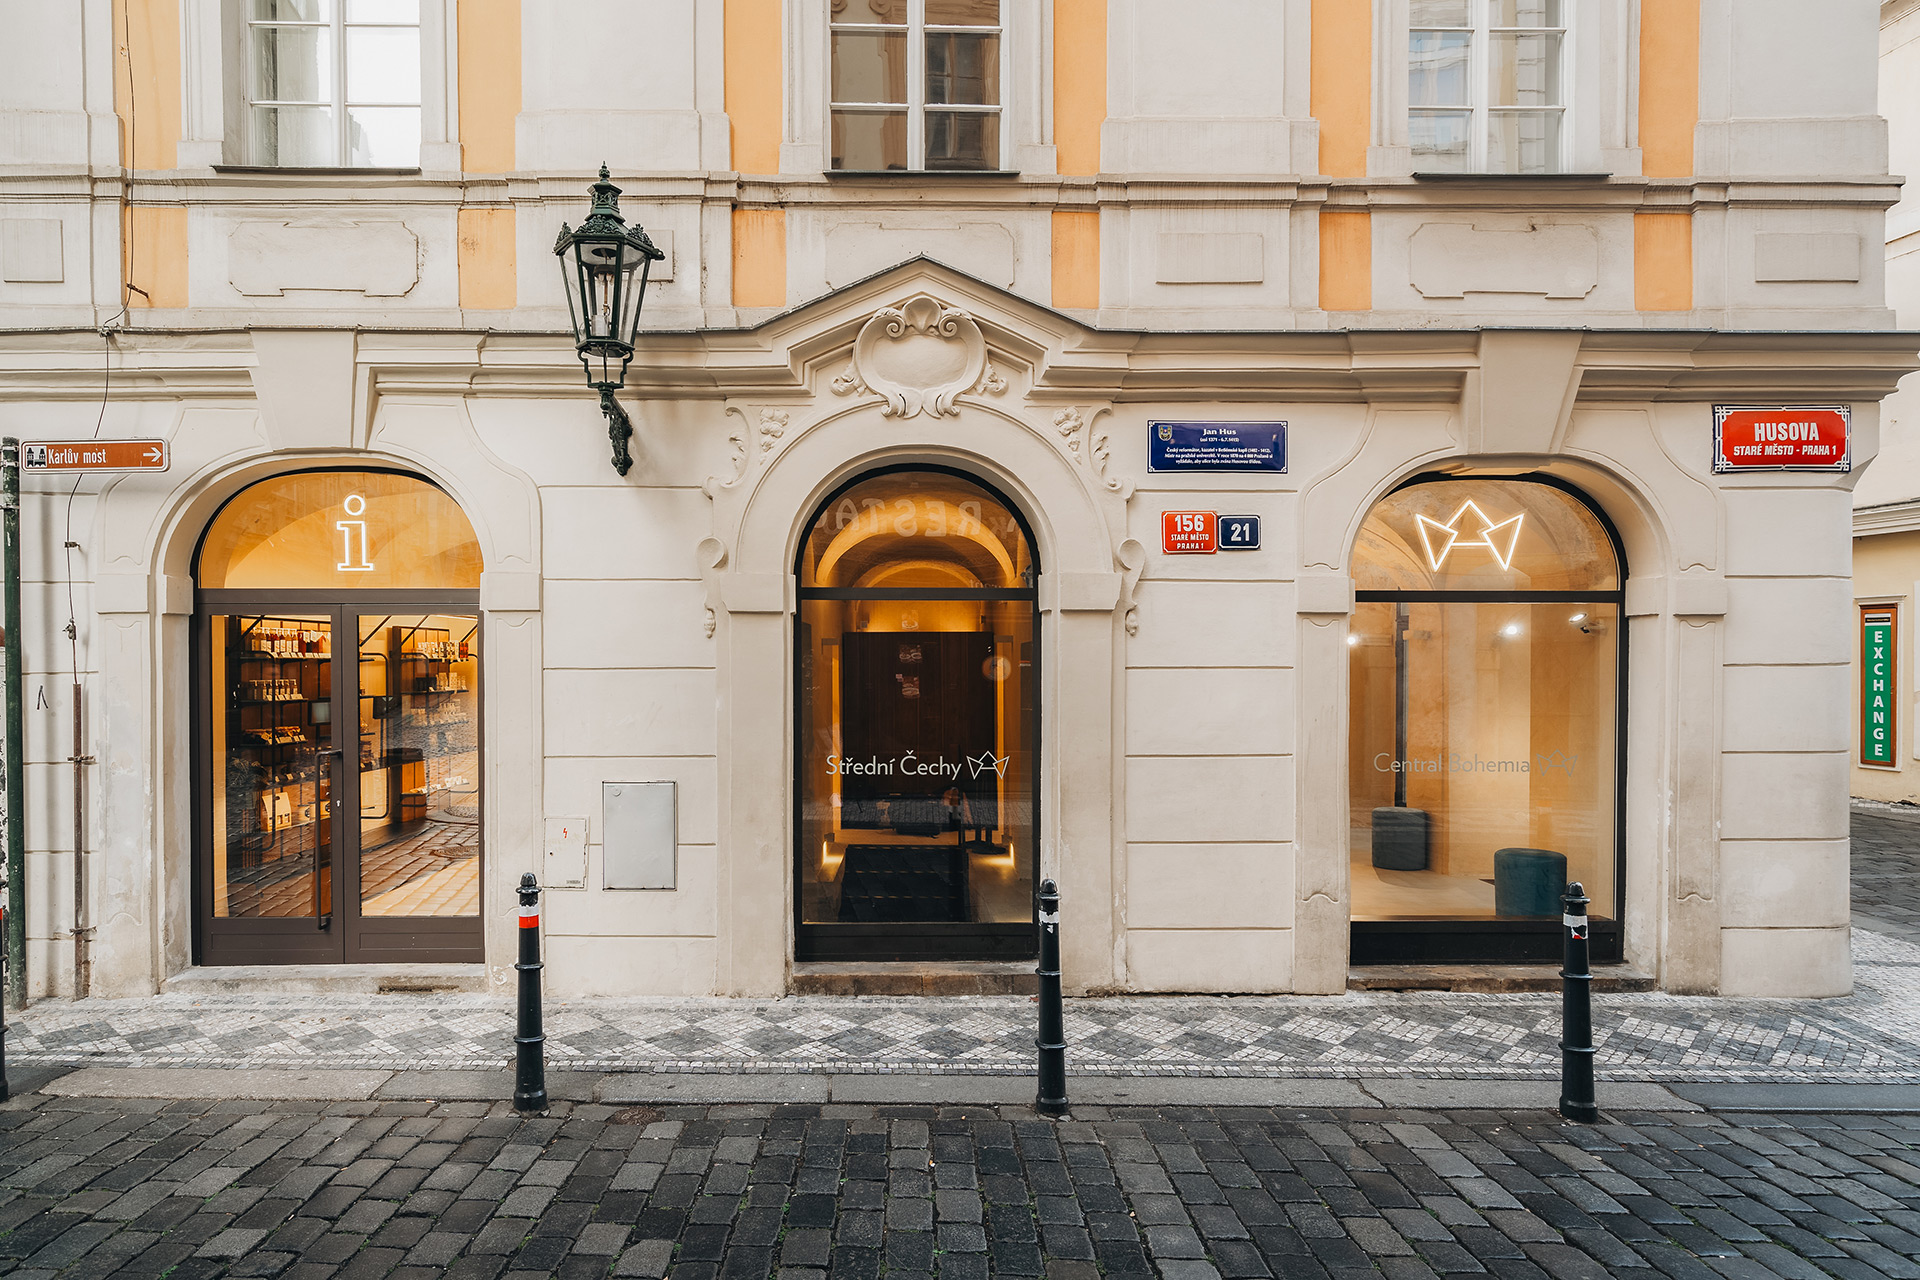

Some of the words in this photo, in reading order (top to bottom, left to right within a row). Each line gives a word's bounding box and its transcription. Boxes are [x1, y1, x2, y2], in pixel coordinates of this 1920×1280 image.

[1203, 428, 1217, 436] Jan
[1754, 422, 1820, 442] HUSOVA
[48, 448, 79, 464] Karlův
[83, 449, 107, 464] most
[1733, 443, 1763, 456] STARÉ
[1764, 442, 1794, 456] MĚSTO
[1802, 445, 1830, 456] PRAHA
[1832, 445, 1837, 456] 1
[1174, 514, 1205, 532] 156
[1170, 532, 1189, 541] STARÉ
[1190, 531, 1210, 541] MĚSTO
[1230, 523, 1250, 542] 21
[1176, 542, 1200, 550] PRAHA
[1200, 542, 1204, 550] 1
[1873, 631, 1884, 756] EXCHANGE
[825, 753, 896, 775] Střední
[900, 749, 962, 781] Čechy
[1373, 752, 1442, 773] Central
[1449, 752, 1531, 773] Bohemia
